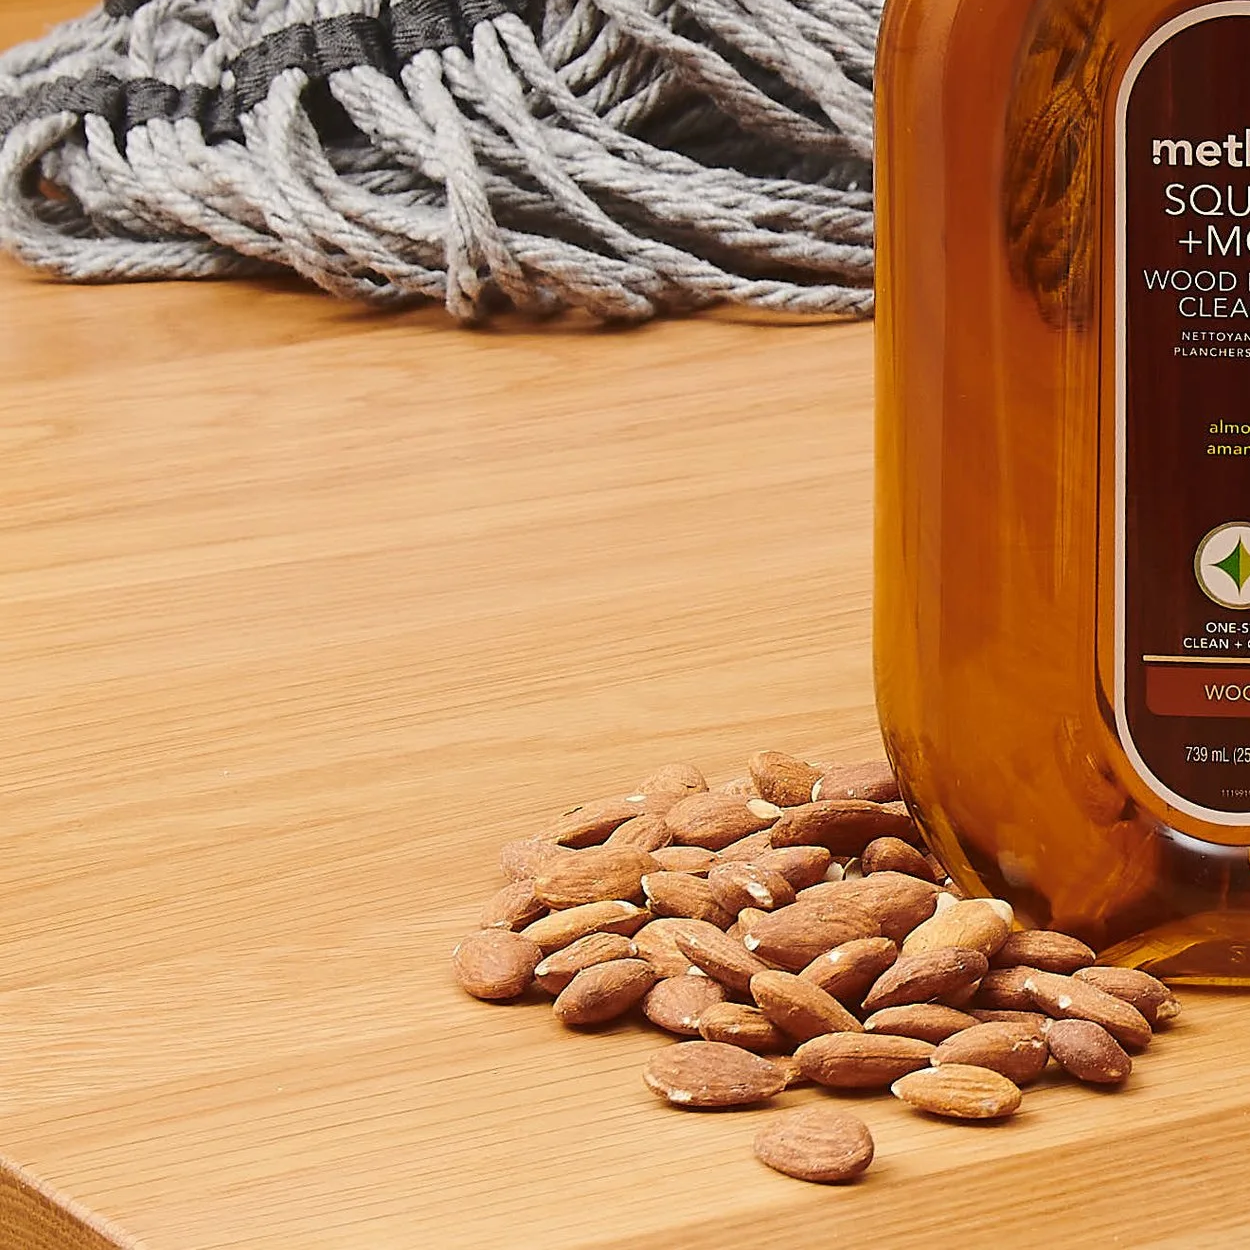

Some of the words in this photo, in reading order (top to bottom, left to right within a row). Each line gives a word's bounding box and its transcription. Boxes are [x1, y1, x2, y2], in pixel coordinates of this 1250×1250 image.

[1143, 269, 1237, 292] WOOD
[1183, 637, 1229, 649] CLEAN
[1234, 640, 1243, 649] +
[1185, 746, 1208, 762] 739
[1211, 747, 1230, 762] mL
